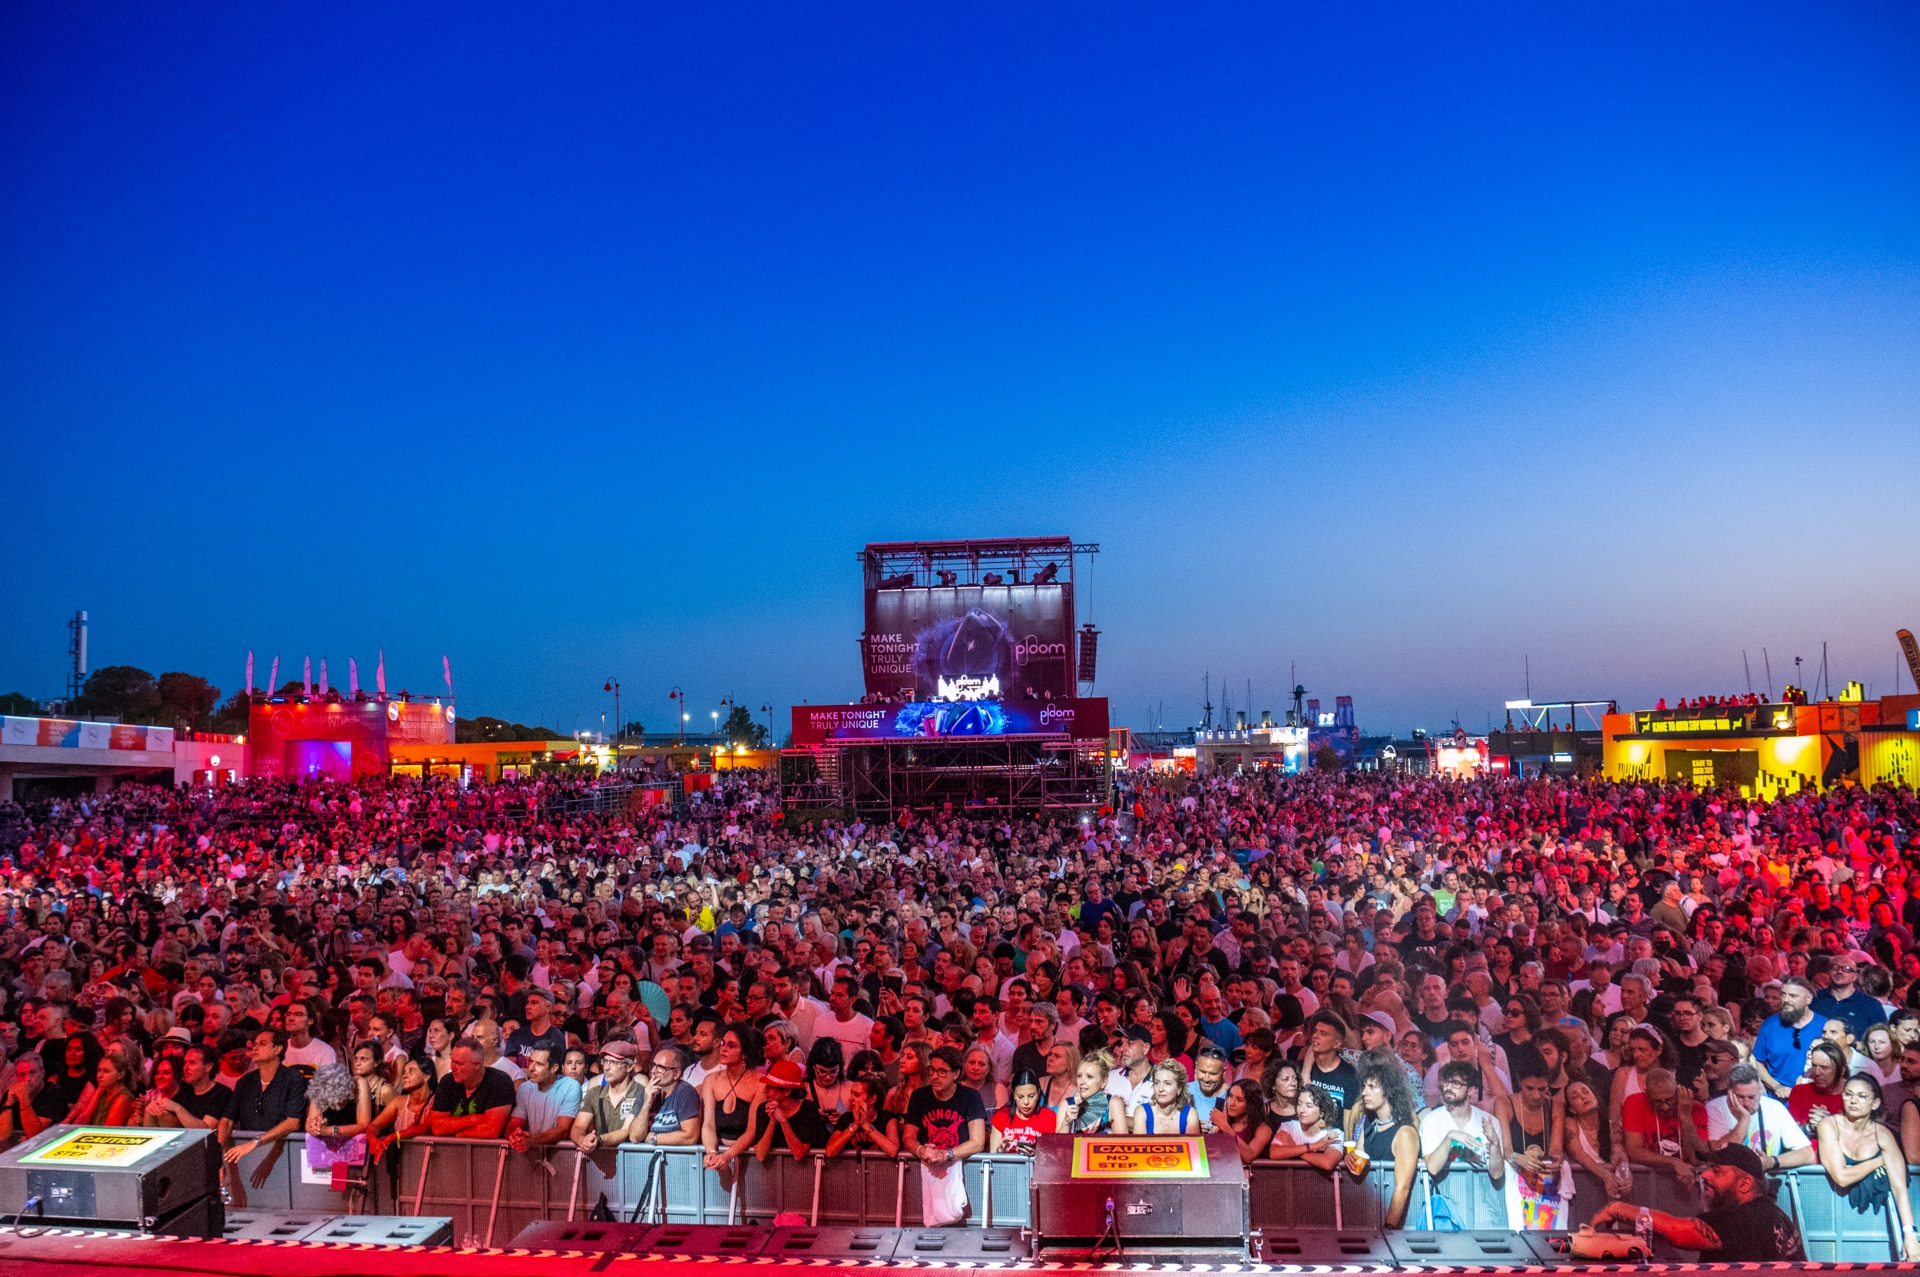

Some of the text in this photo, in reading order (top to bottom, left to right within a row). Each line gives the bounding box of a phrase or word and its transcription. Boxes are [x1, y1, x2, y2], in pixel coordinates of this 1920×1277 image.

[870, 633, 902, 643] MAKE
[870, 643, 921, 653] TONIGHT
[1015, 634, 1066, 666] ploom
[870, 654, 903, 664] TRULY
[871, 664, 912, 674] UNIQUE
[810, 710, 887, 720] MAKE TONIGHT
[1040, 703, 1075, 725] ploom
[810, 720, 879, 730] TRULY UNIQUE
[922, 1108, 965, 1127] HUNGRY
[79, 1135, 146, 1145] CAUTION
[1099, 1145, 1178, 1153] CAUTION
